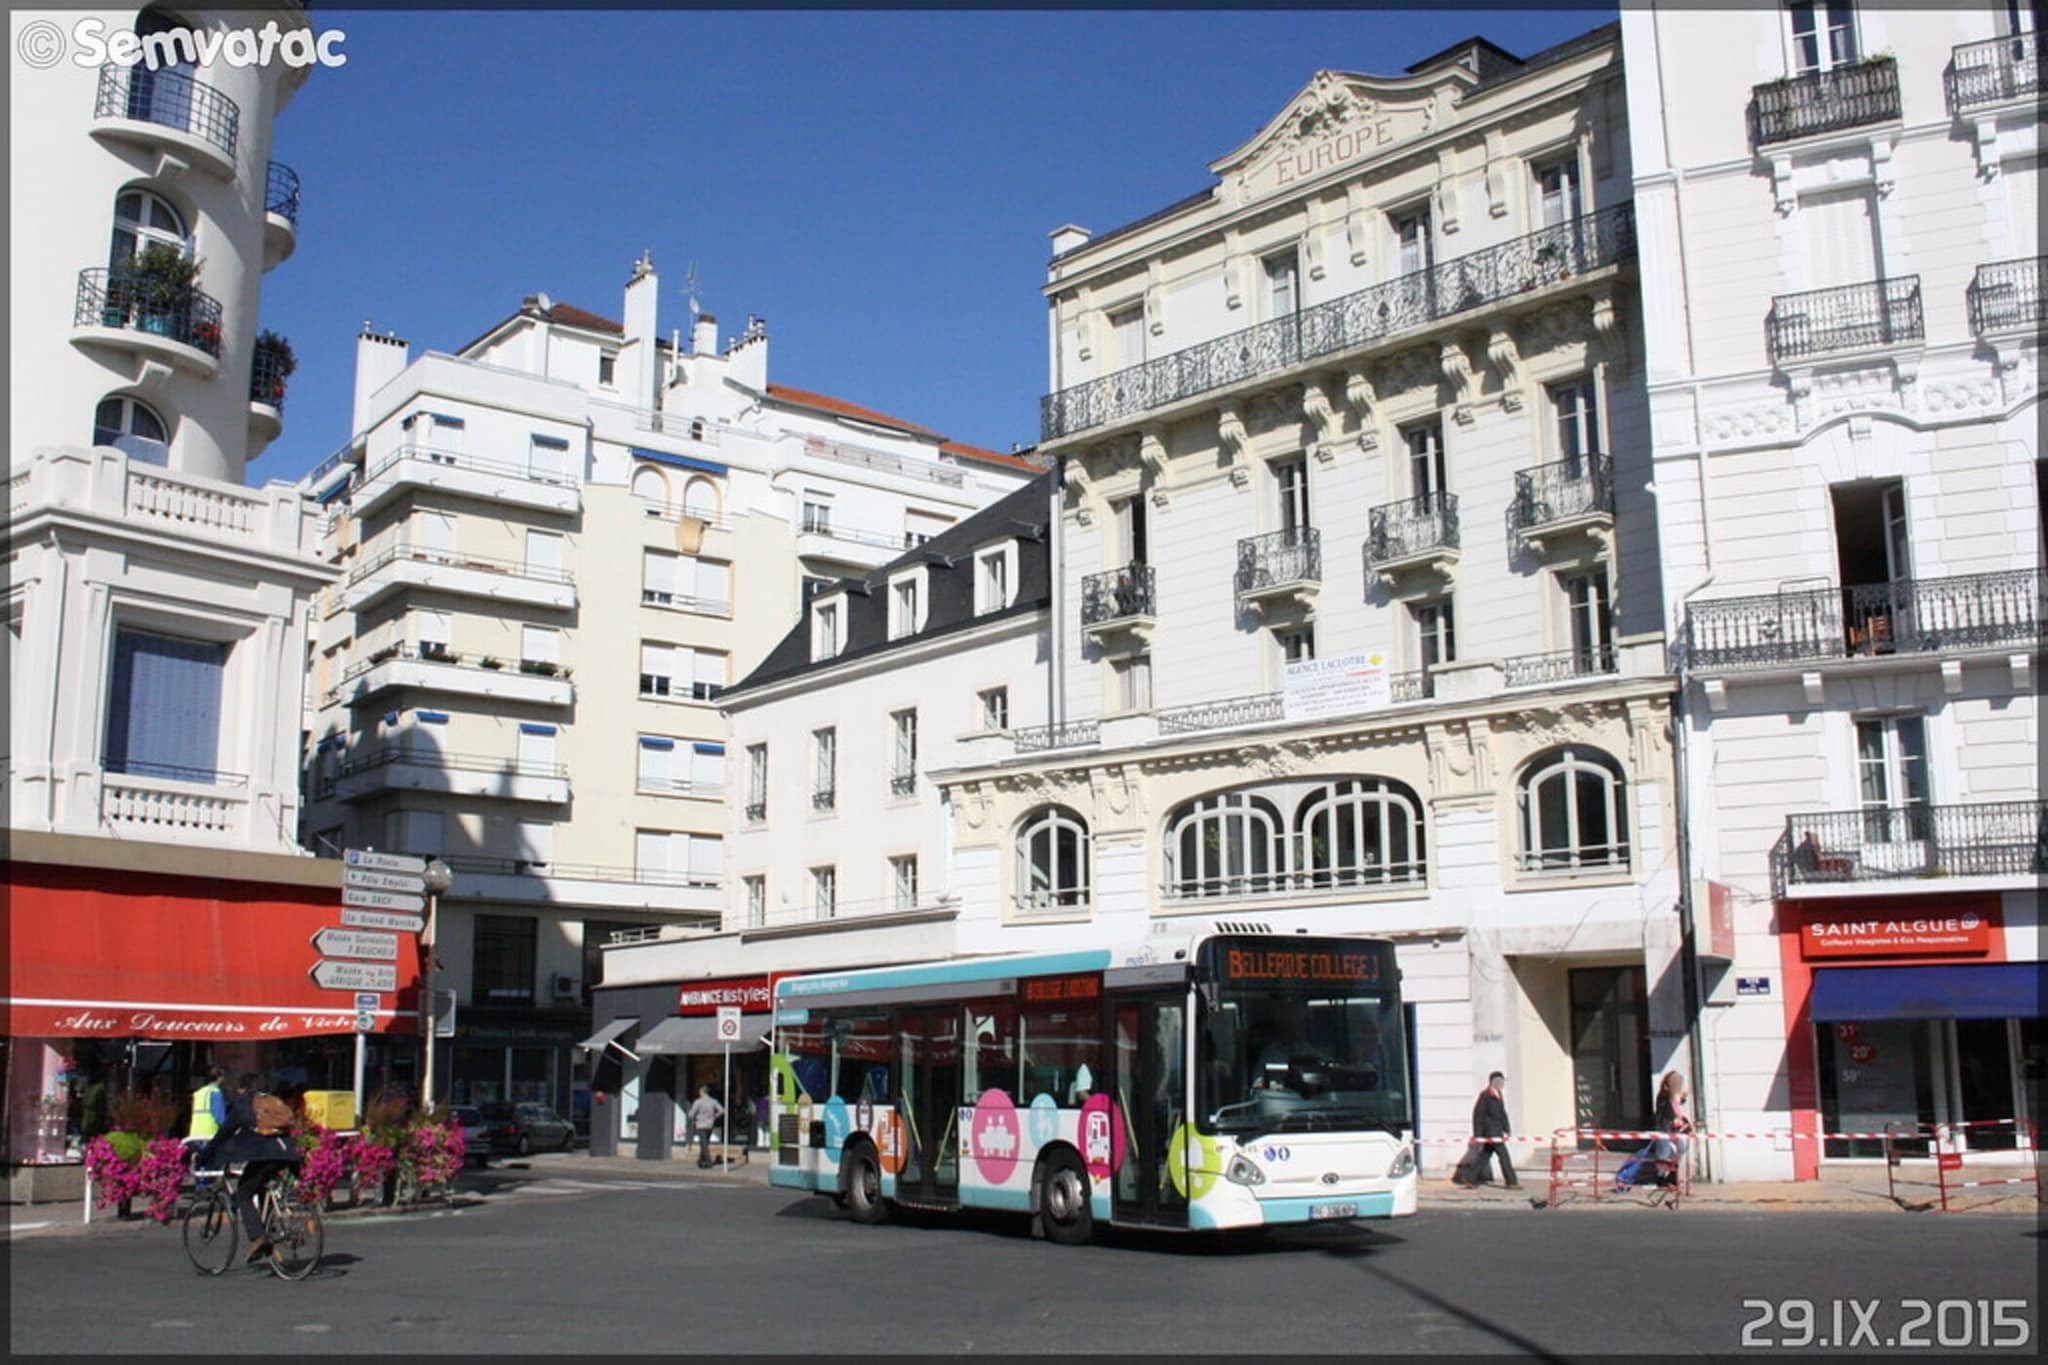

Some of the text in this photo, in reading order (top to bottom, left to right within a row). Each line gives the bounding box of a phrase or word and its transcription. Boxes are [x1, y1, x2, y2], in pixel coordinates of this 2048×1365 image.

[1276, 117, 1393, 185] EUROPE
[1811, 919, 1959, 937] SAINT ALGUE
[1311, 952, 1369, 980] COLLEGE
[55, 1011, 117, 1031] Aux
[130, 1013, 246, 1033] Douceurs
[259, 1015, 289, 1032] de
